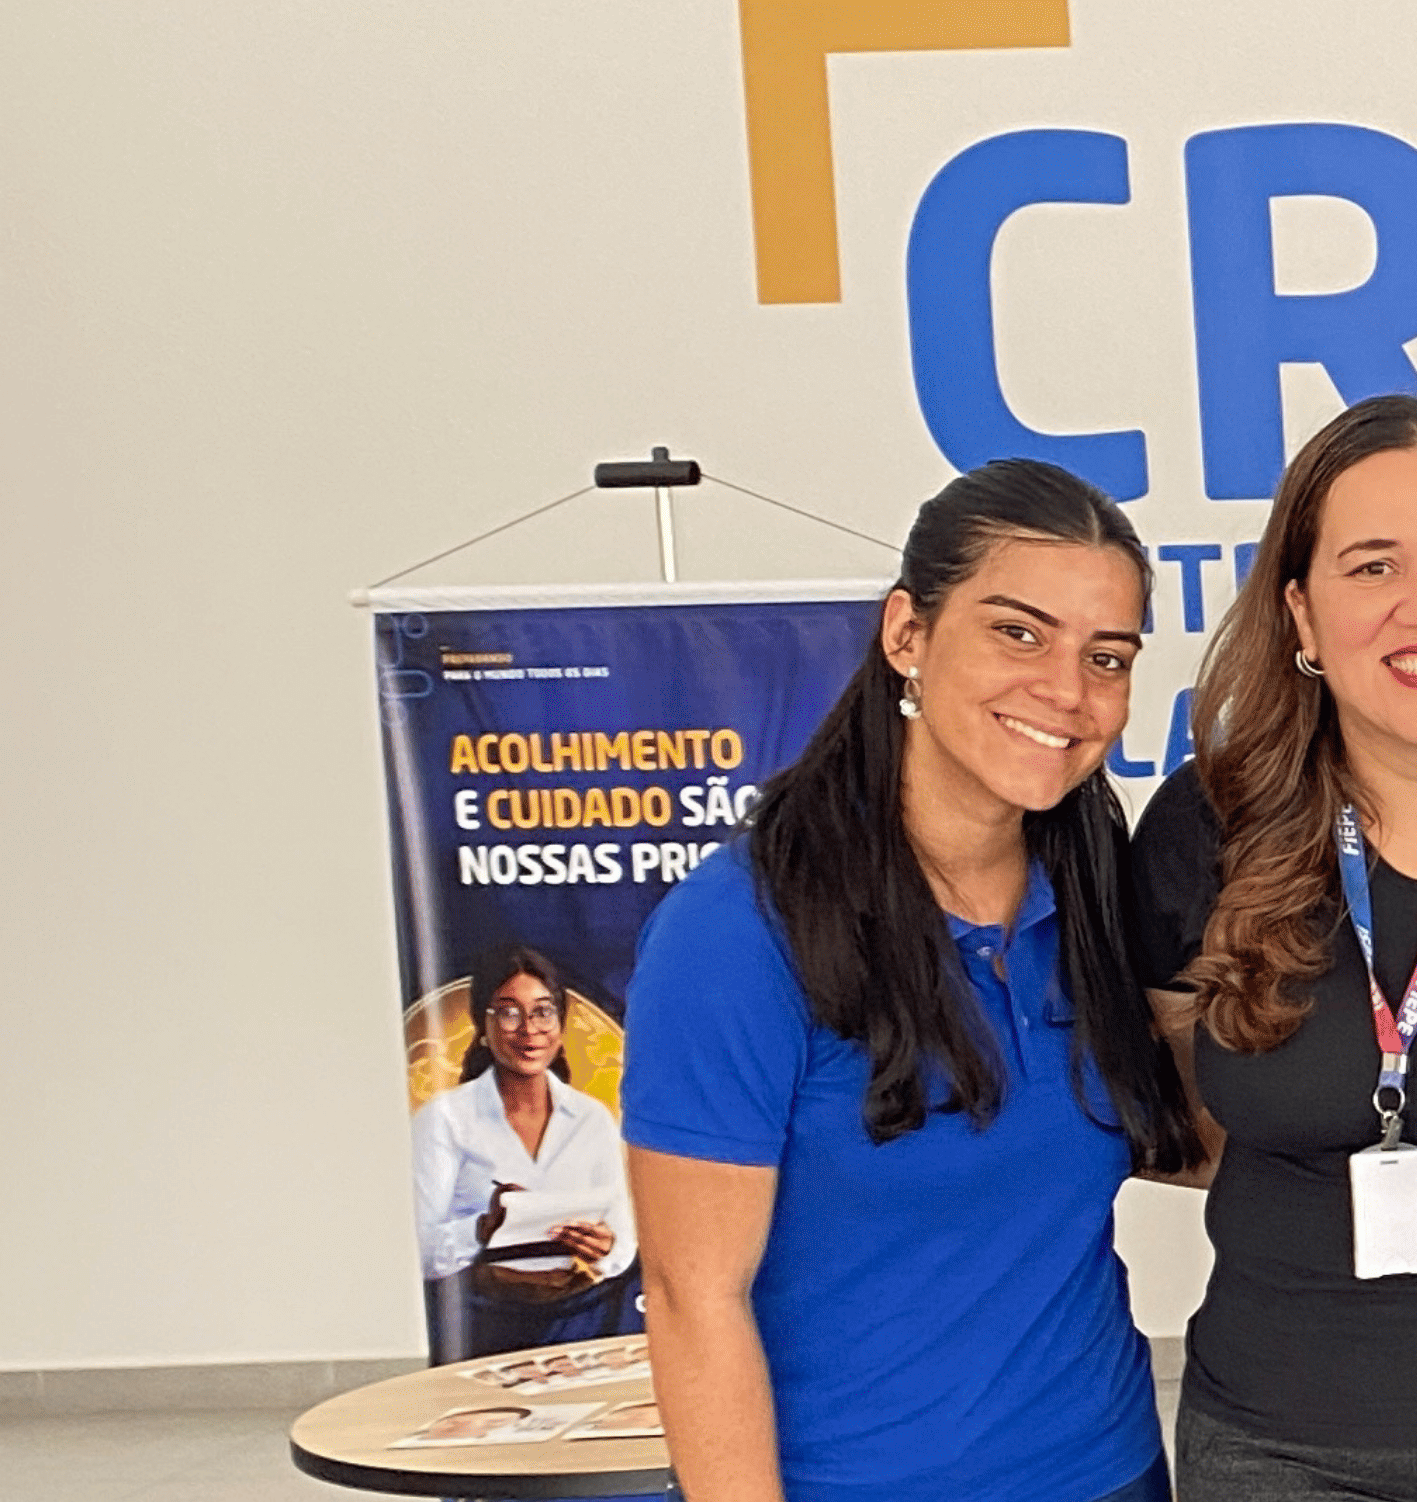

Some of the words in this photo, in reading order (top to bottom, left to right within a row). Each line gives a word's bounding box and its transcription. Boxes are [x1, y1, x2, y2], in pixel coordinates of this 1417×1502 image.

[450, 729, 743, 774] ACOLHIMENTO
[455, 790, 480, 830] E
[487, 787, 673, 829] CUIDADO
[680, 777, 762, 827] SÃO
[459, 844, 623, 885] NOSSAS
